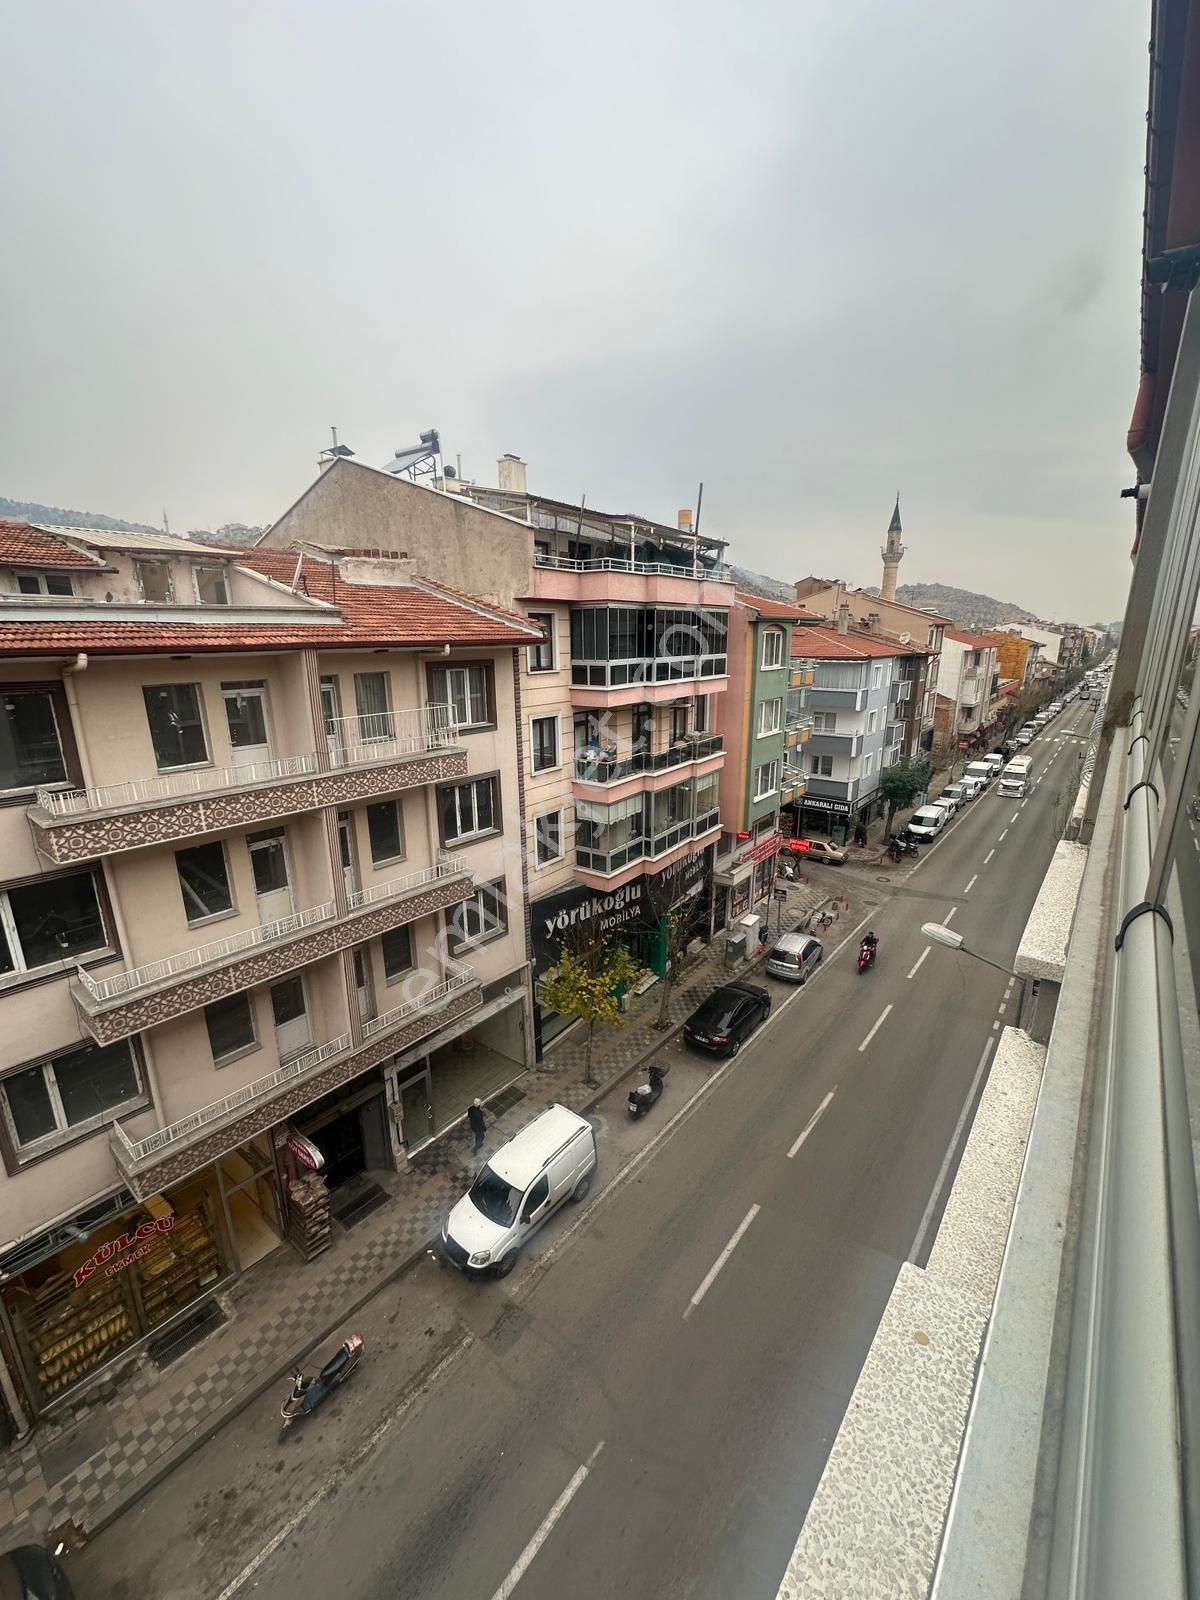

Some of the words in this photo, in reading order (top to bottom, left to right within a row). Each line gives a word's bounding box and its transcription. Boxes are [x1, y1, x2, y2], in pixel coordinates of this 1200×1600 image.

[803, 799, 833, 809] ANKARALI
[544, 884, 641, 939] yörükoğlu
[600, 905, 641, 931] MOBİLYA
[73, 1214, 174, 1288] KÜLCÜ
[105, 1243, 151, 1277] EKMEK
